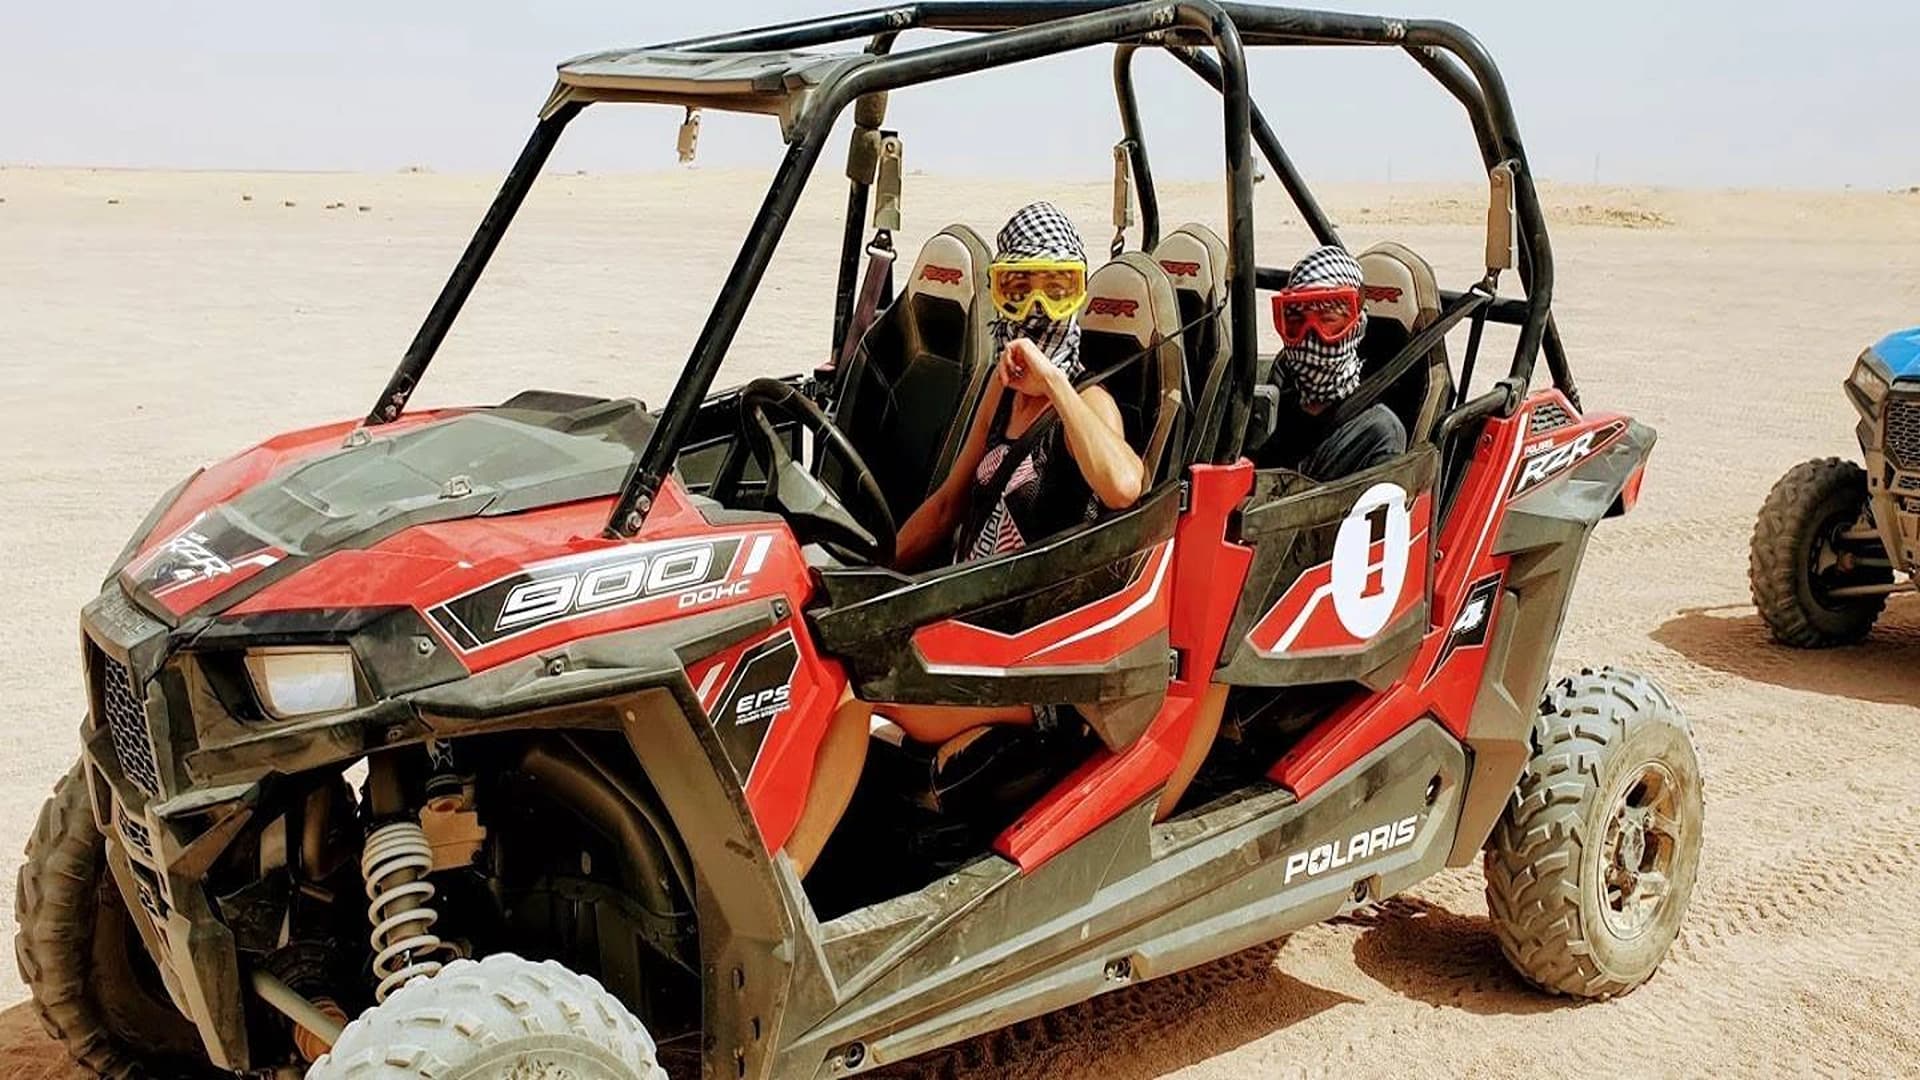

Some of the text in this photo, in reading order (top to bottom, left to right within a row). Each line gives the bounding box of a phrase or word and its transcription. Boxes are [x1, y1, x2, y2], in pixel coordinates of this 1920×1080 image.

[1085, 297, 1140, 317] RZR
[1515, 431, 1596, 493] RZR
[494, 542, 715, 632] 900
[678, 579, 752, 609] DOHC
[736, 685, 791, 713] EPS
[1284, 814, 1418, 885] POLARIS
